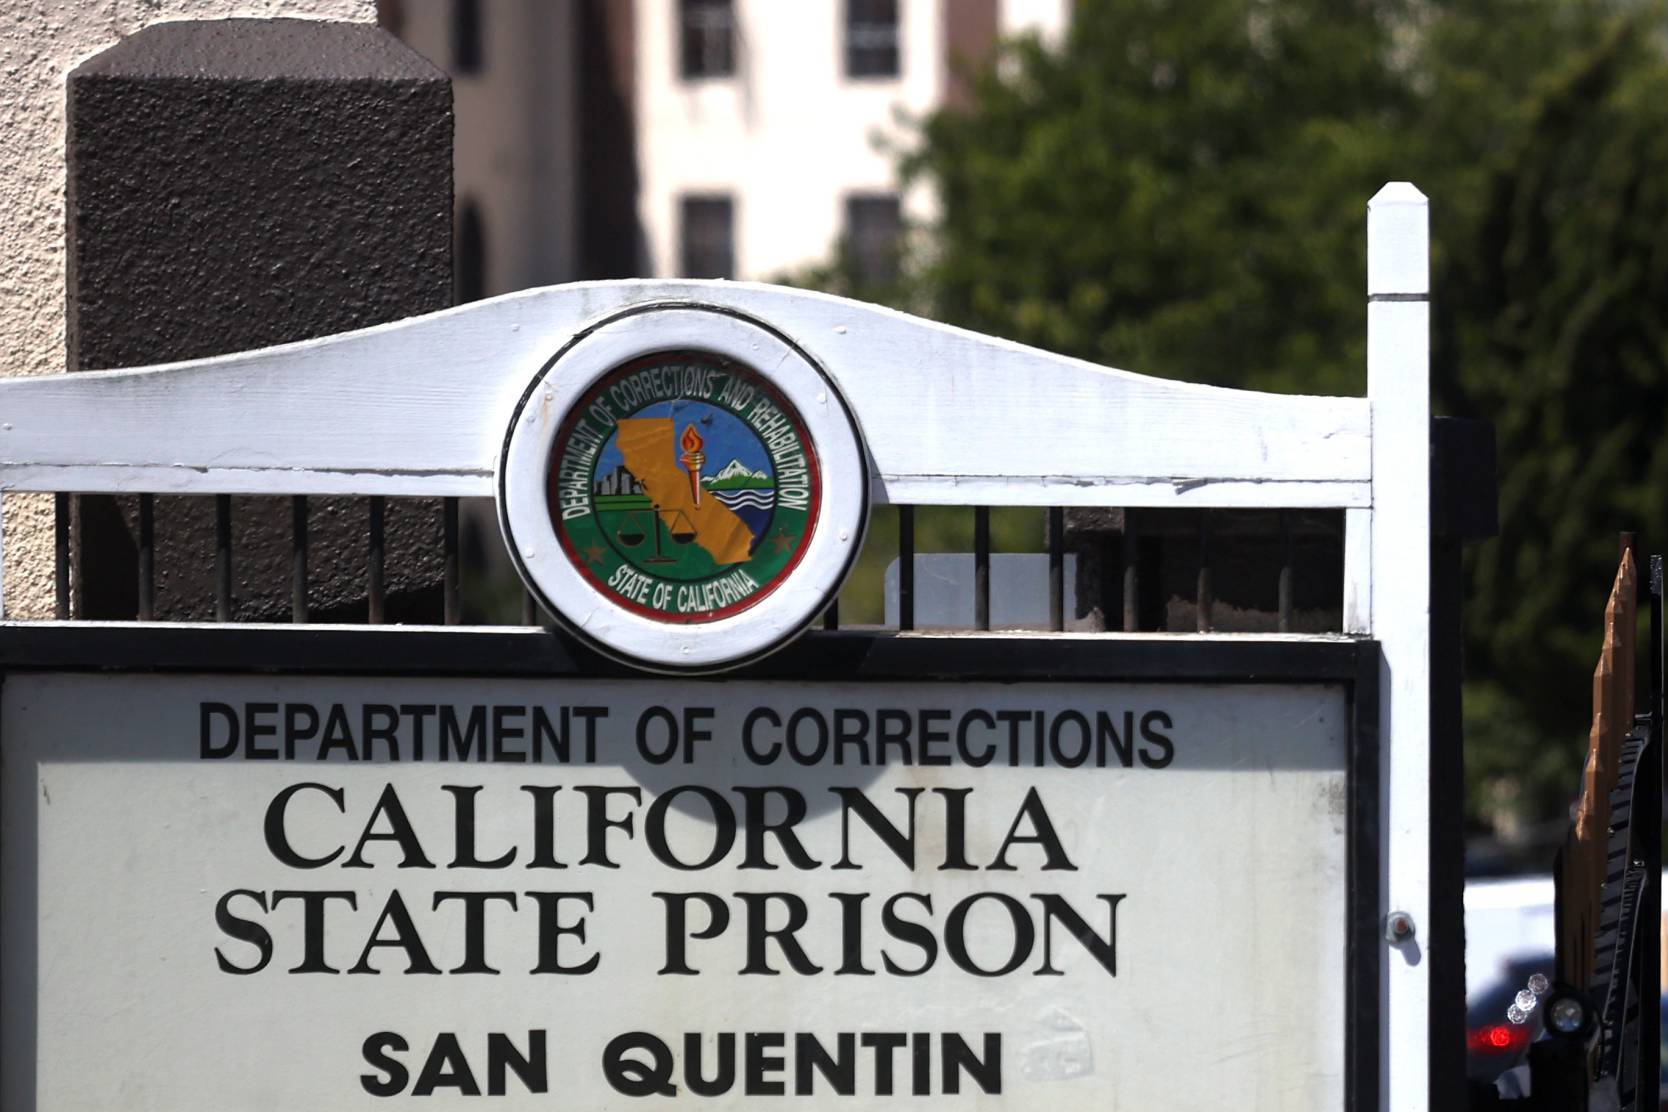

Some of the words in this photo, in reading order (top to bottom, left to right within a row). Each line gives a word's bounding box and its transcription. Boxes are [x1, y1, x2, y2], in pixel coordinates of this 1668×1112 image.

[560, 419, 604, 521] DEPARTMENT
[591, 396, 617, 430] OF
[611, 365, 717, 414] CORRECTIONS
[718, 372, 755, 412] AND
[747, 399, 810, 512] REHABILITATION
[607, 564, 652, 605] STATE
[652, 582, 673, 611] OF
[677, 568, 760, 613] CALIFORNIA
[199, 701, 611, 764] DEPARTMENT
[635, 704, 717, 766] OF
[740, 705, 1175, 770] CORRECTIONS
[263, 781, 1080, 873] CALIFORNIA
[213, 888, 601, 976] STATE
[651, 890, 1128, 979] PRISON
[359, 1028, 549, 1098] SAN
[601, 1030, 1003, 1098] QUENTIN
